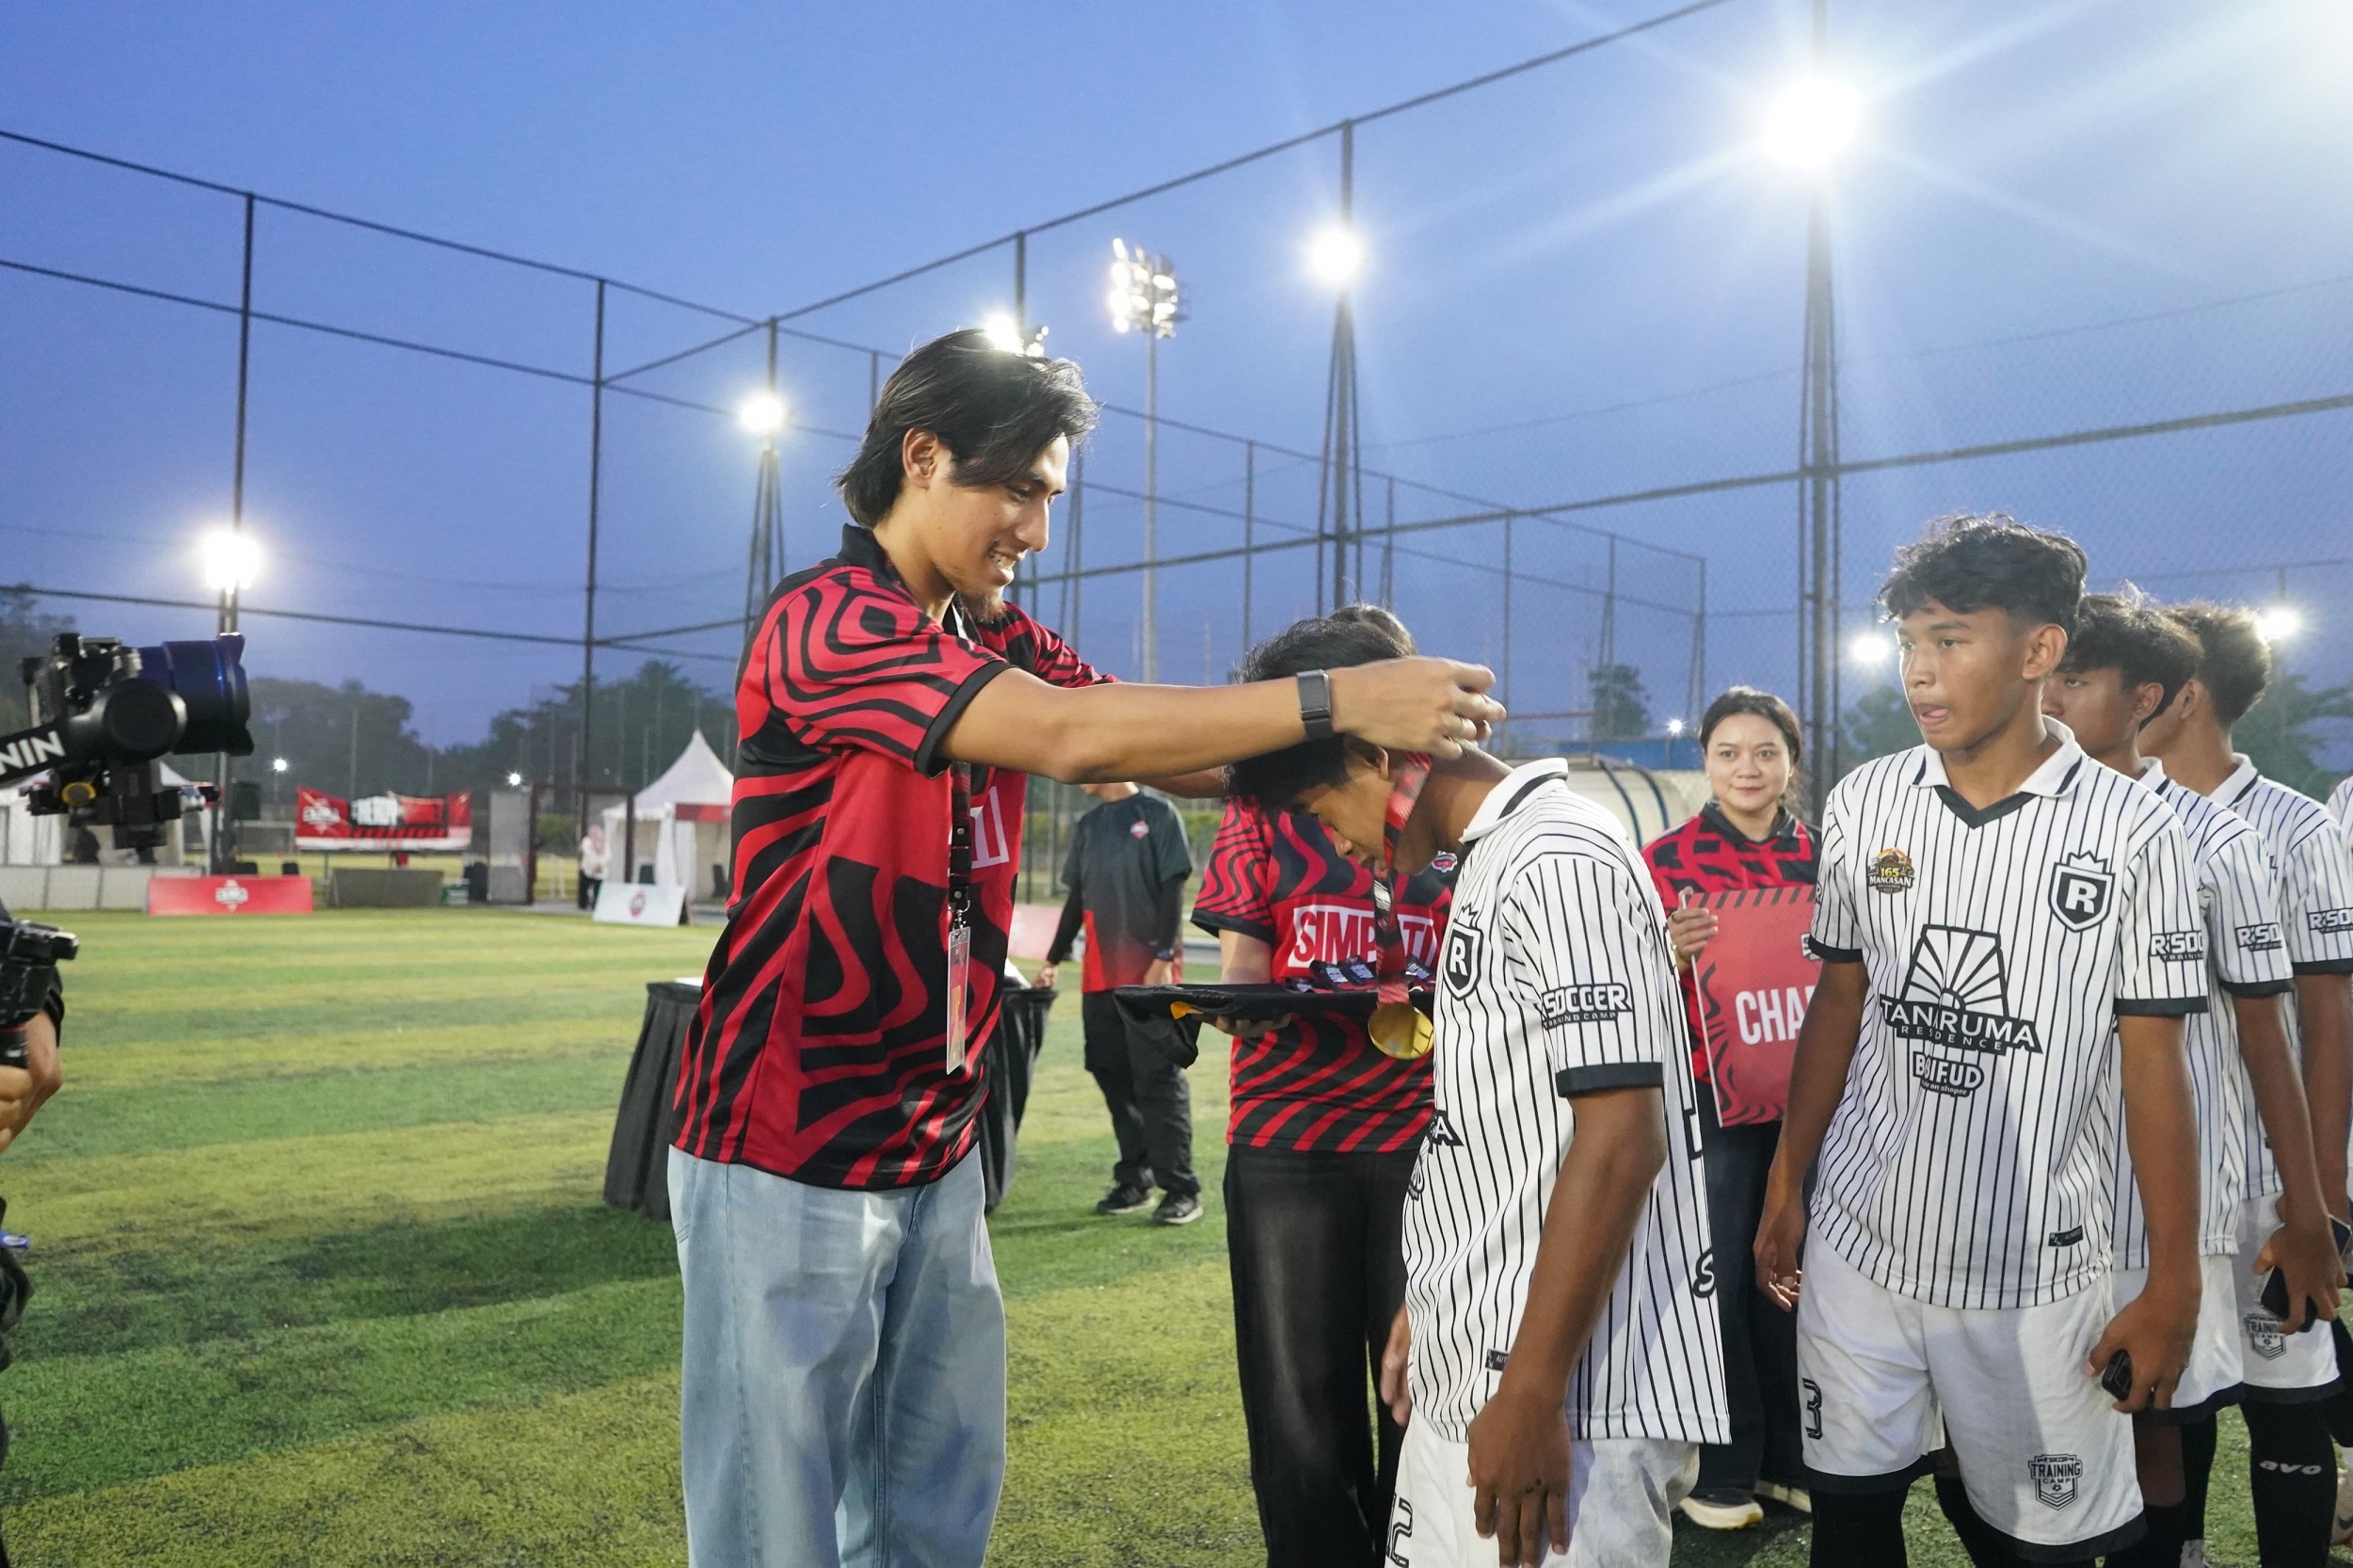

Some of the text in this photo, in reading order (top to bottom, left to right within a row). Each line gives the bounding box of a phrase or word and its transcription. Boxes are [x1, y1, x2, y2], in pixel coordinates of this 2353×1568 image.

[1881, 868, 1899, 877] 165
[2065, 878, 2098, 914] R
[1449, 936, 1468, 976] R
[1802, 1377, 1823, 1440] 3
[2030, 1462, 2081, 1478] TRAINING
